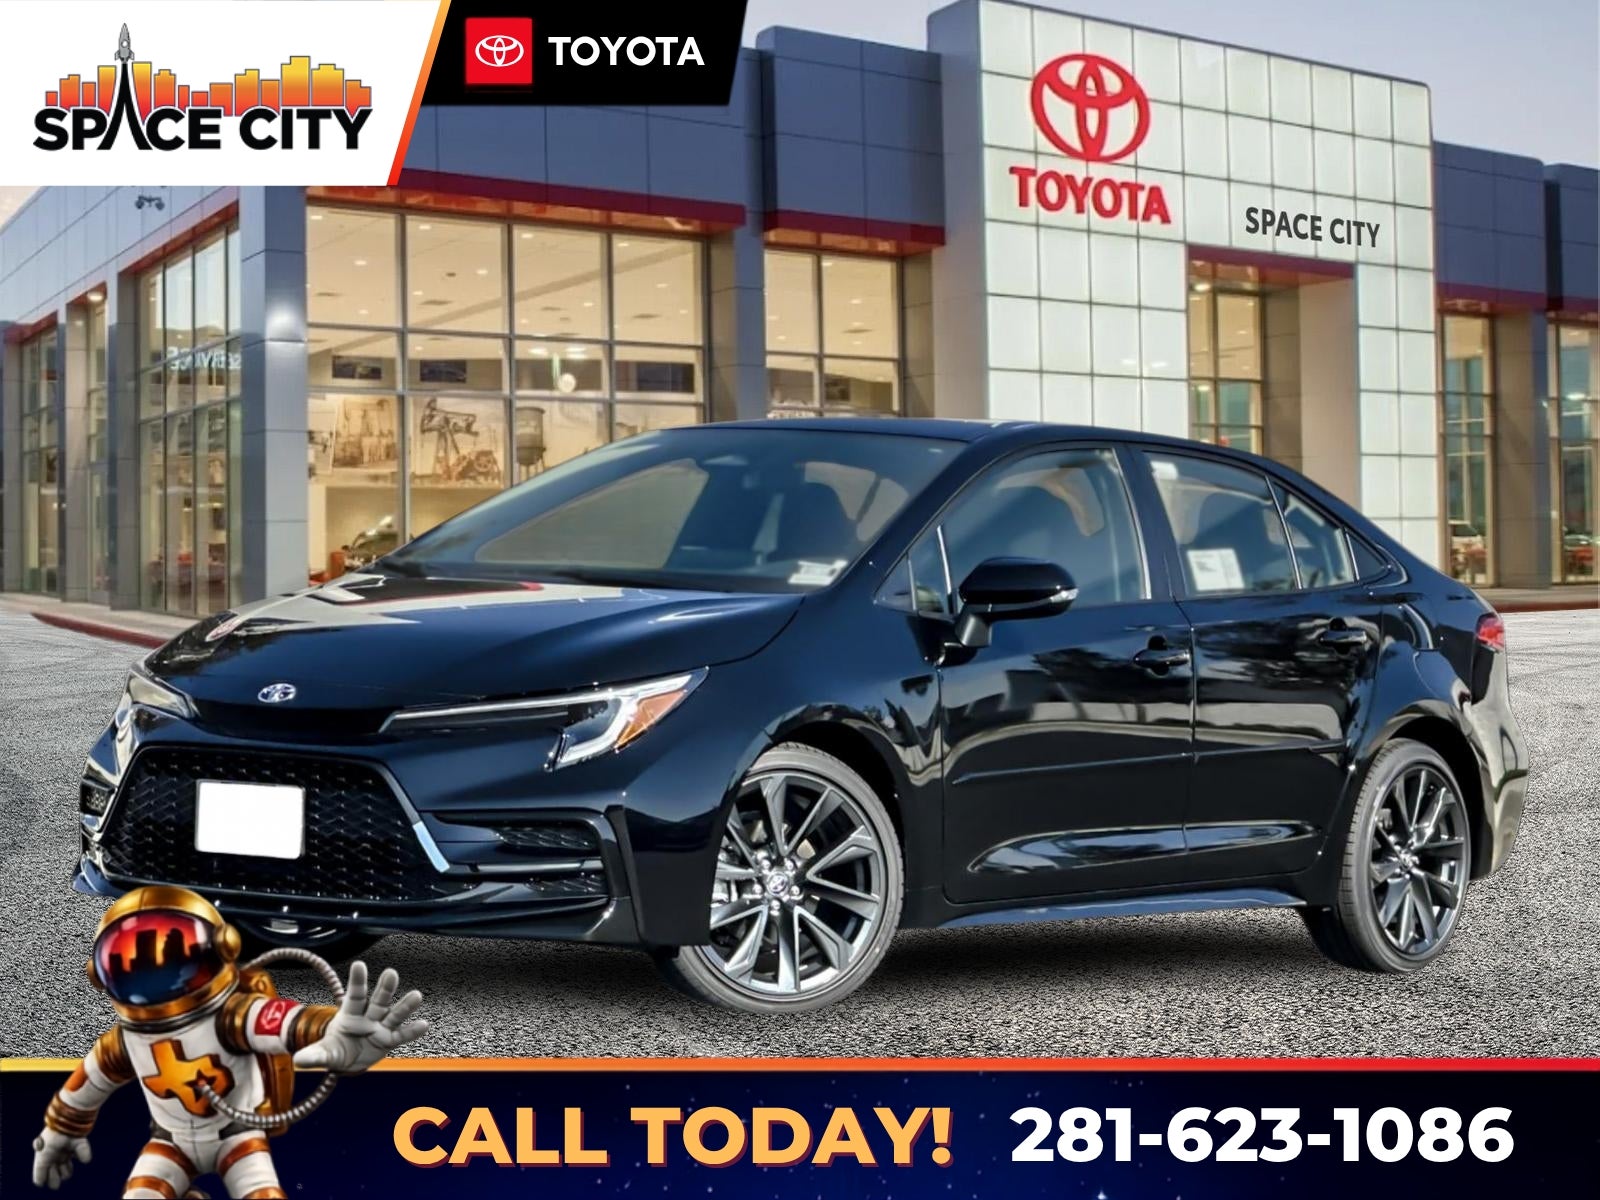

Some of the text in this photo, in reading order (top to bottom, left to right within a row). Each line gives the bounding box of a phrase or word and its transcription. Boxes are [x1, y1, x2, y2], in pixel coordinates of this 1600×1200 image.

[1009, 166, 1171, 224] TOYOTA
[1245, 206, 1380, 248] SPACE CITY
